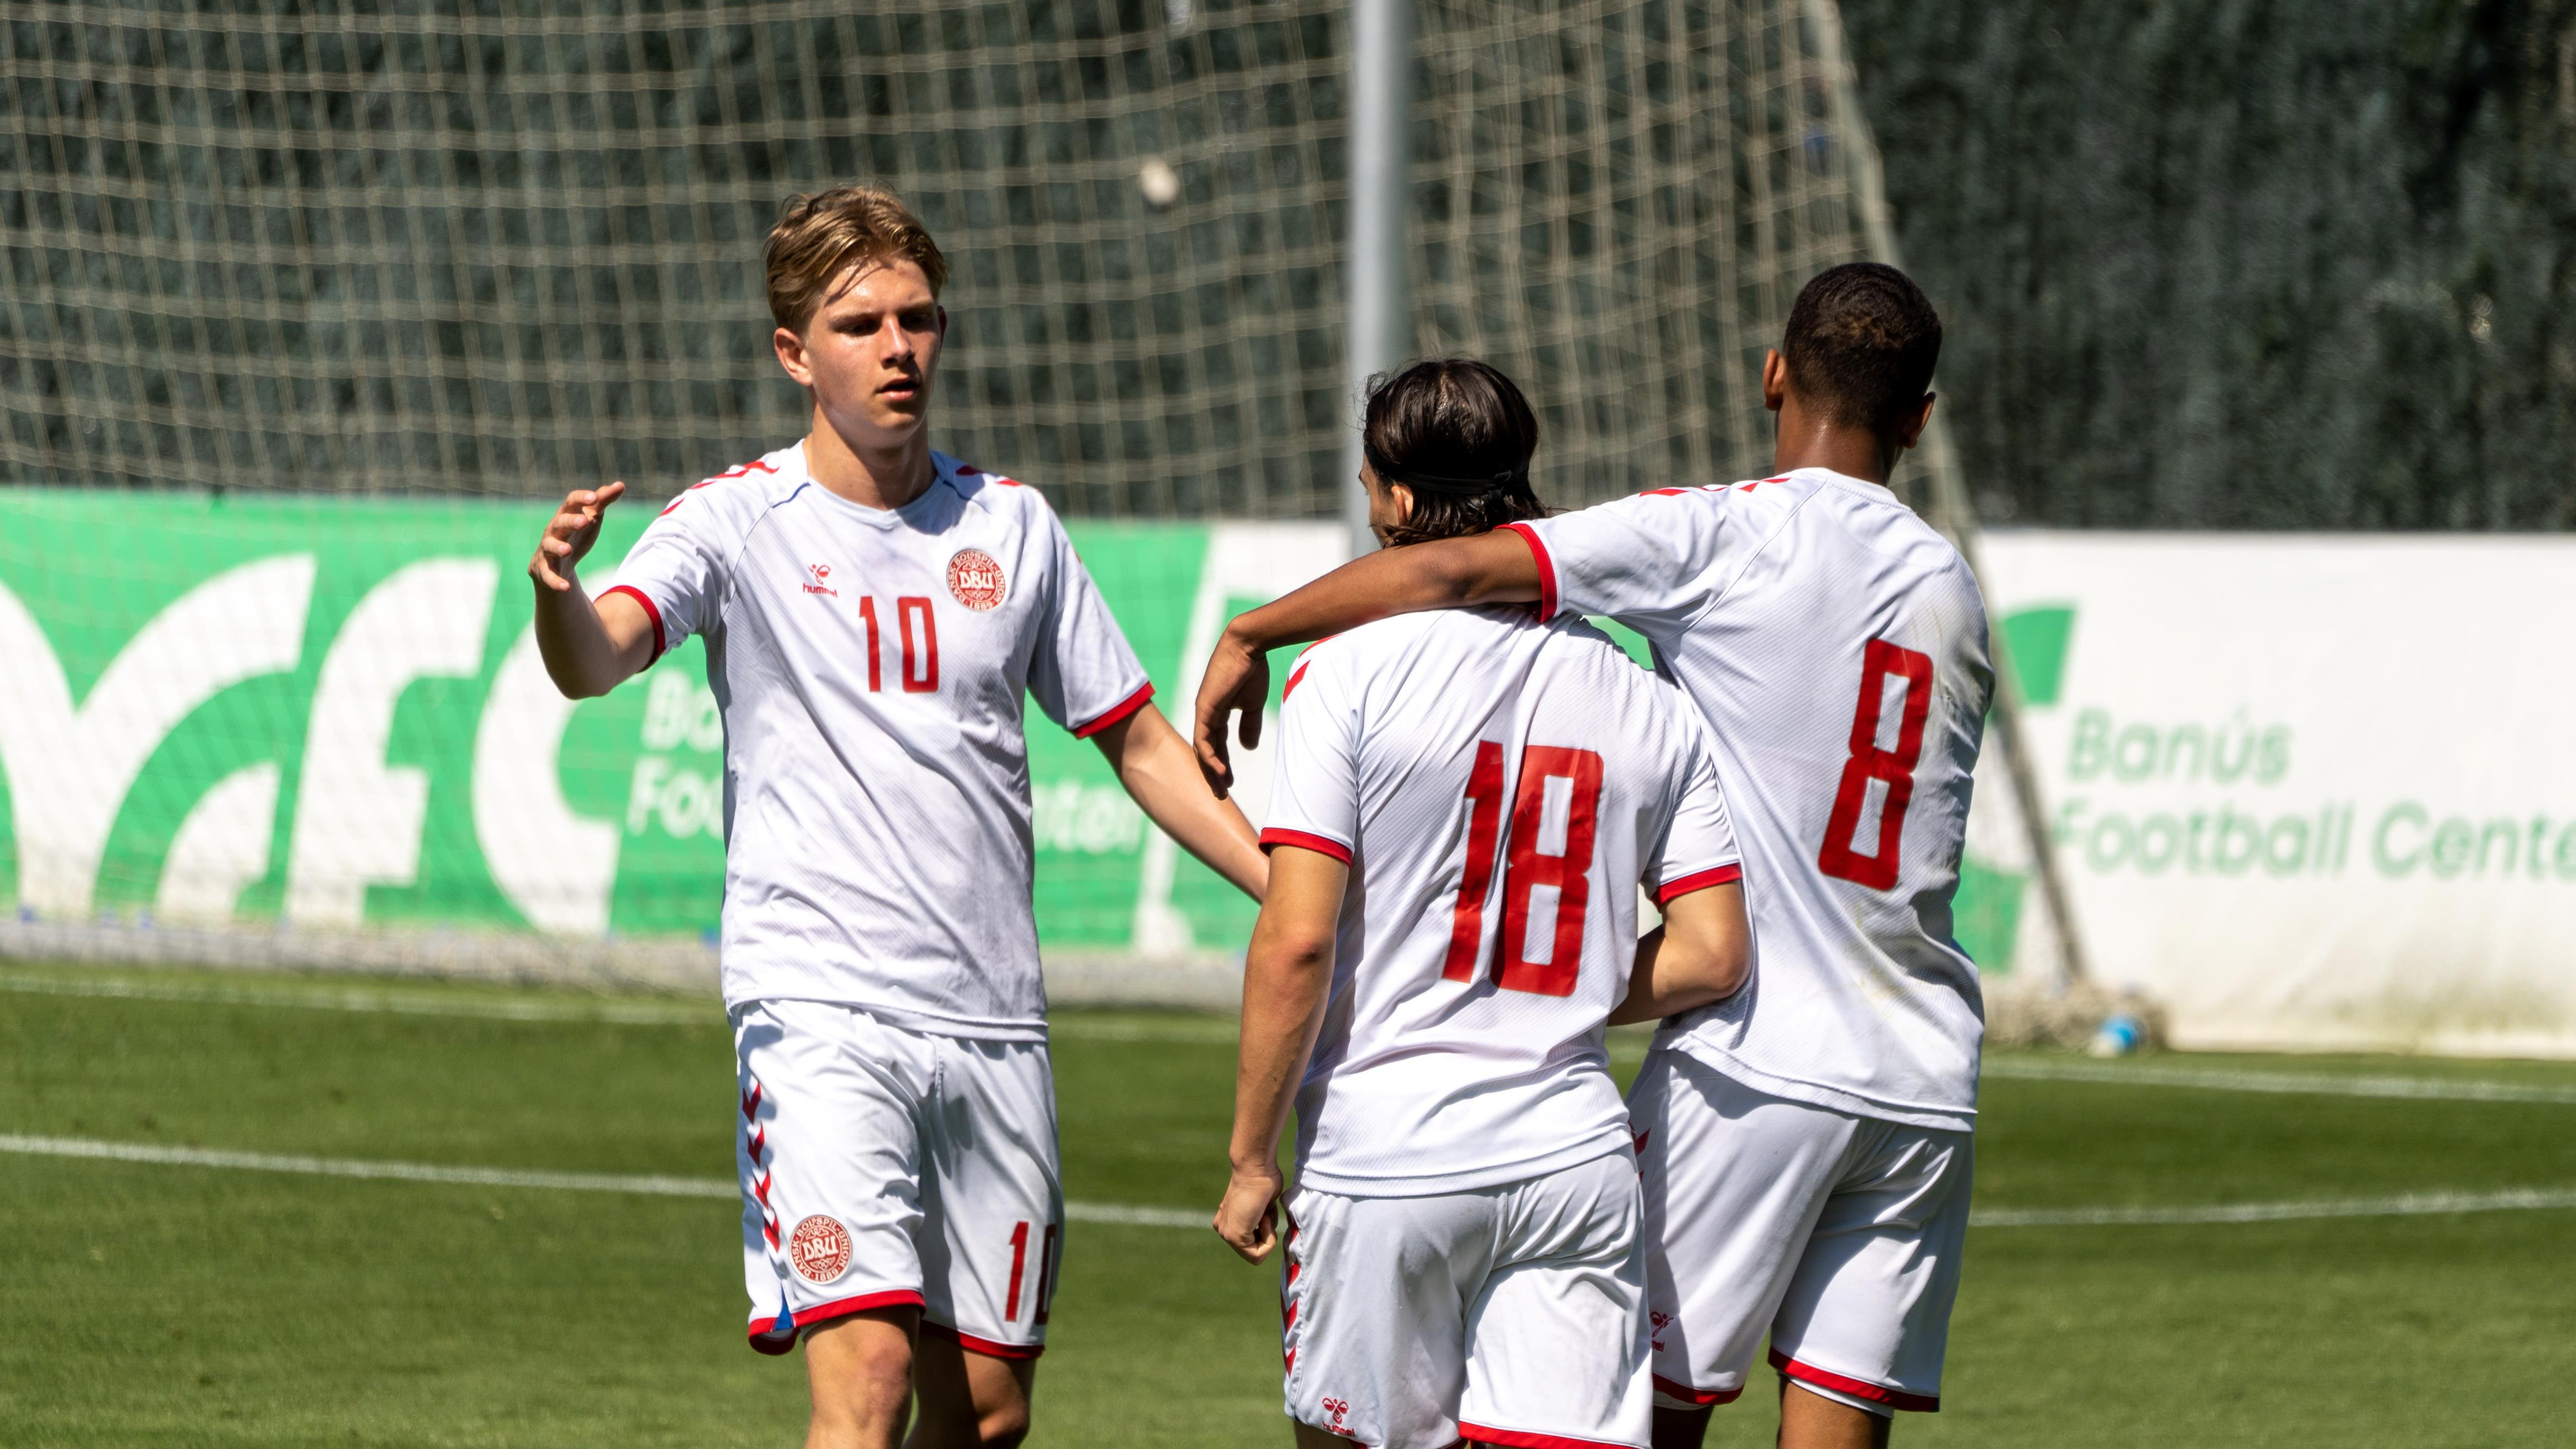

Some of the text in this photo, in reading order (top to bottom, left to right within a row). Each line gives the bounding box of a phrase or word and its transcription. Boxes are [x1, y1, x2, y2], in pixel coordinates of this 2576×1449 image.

[958, 570, 995, 589] DBU
[859, 596, 939, 693] 10
[1819, 639, 1934, 891] 8
[2069, 707, 2291, 783] Banús
[1442, 739, 1604, 997] 18
[2051, 799, 2352, 876] Football
[792, 1240, 811, 1277] DANSK
[802, 1236, 839, 1261] DBU
[1322, 1421, 1355, 1437] hummel
